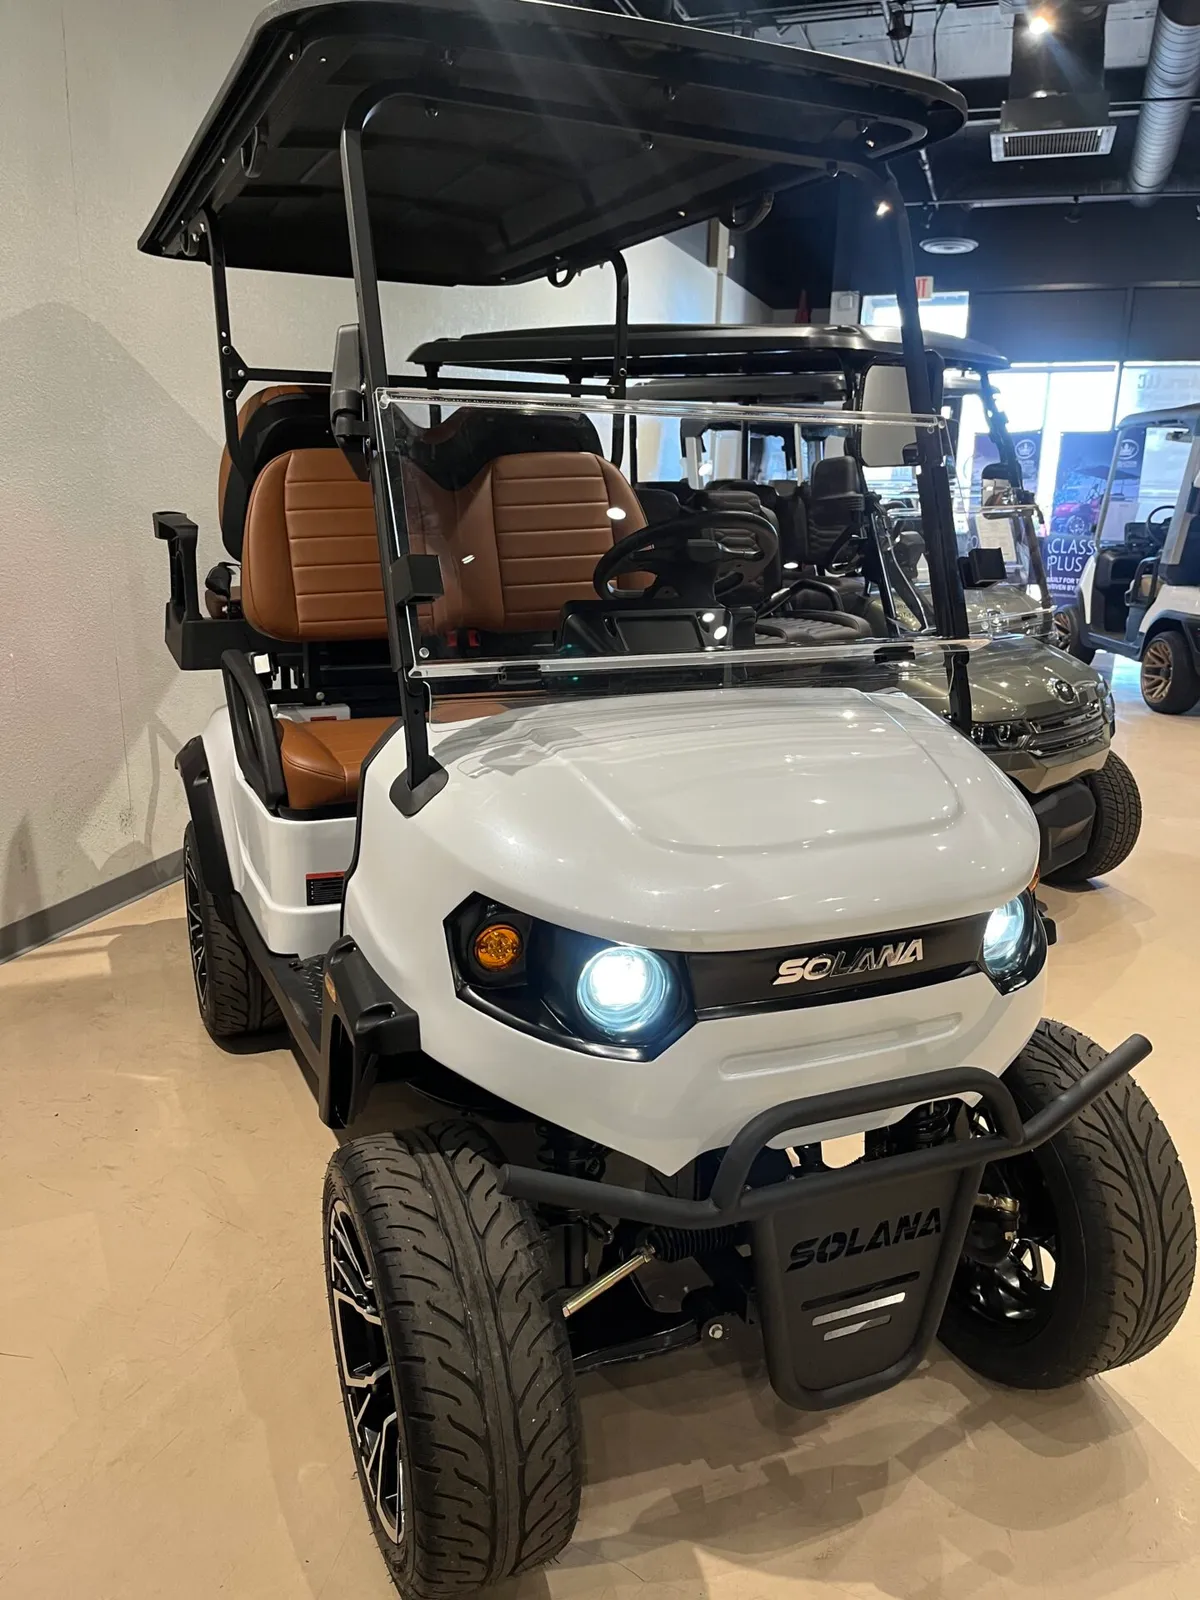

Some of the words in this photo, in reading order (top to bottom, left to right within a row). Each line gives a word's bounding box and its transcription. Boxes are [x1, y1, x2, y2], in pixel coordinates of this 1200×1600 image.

[1048, 538, 1095, 555] CLASS
[1047, 555, 1083, 572] PLUS
[772, 938, 923, 986] SOLANA
[784, 1207, 942, 1273] SOLANA
